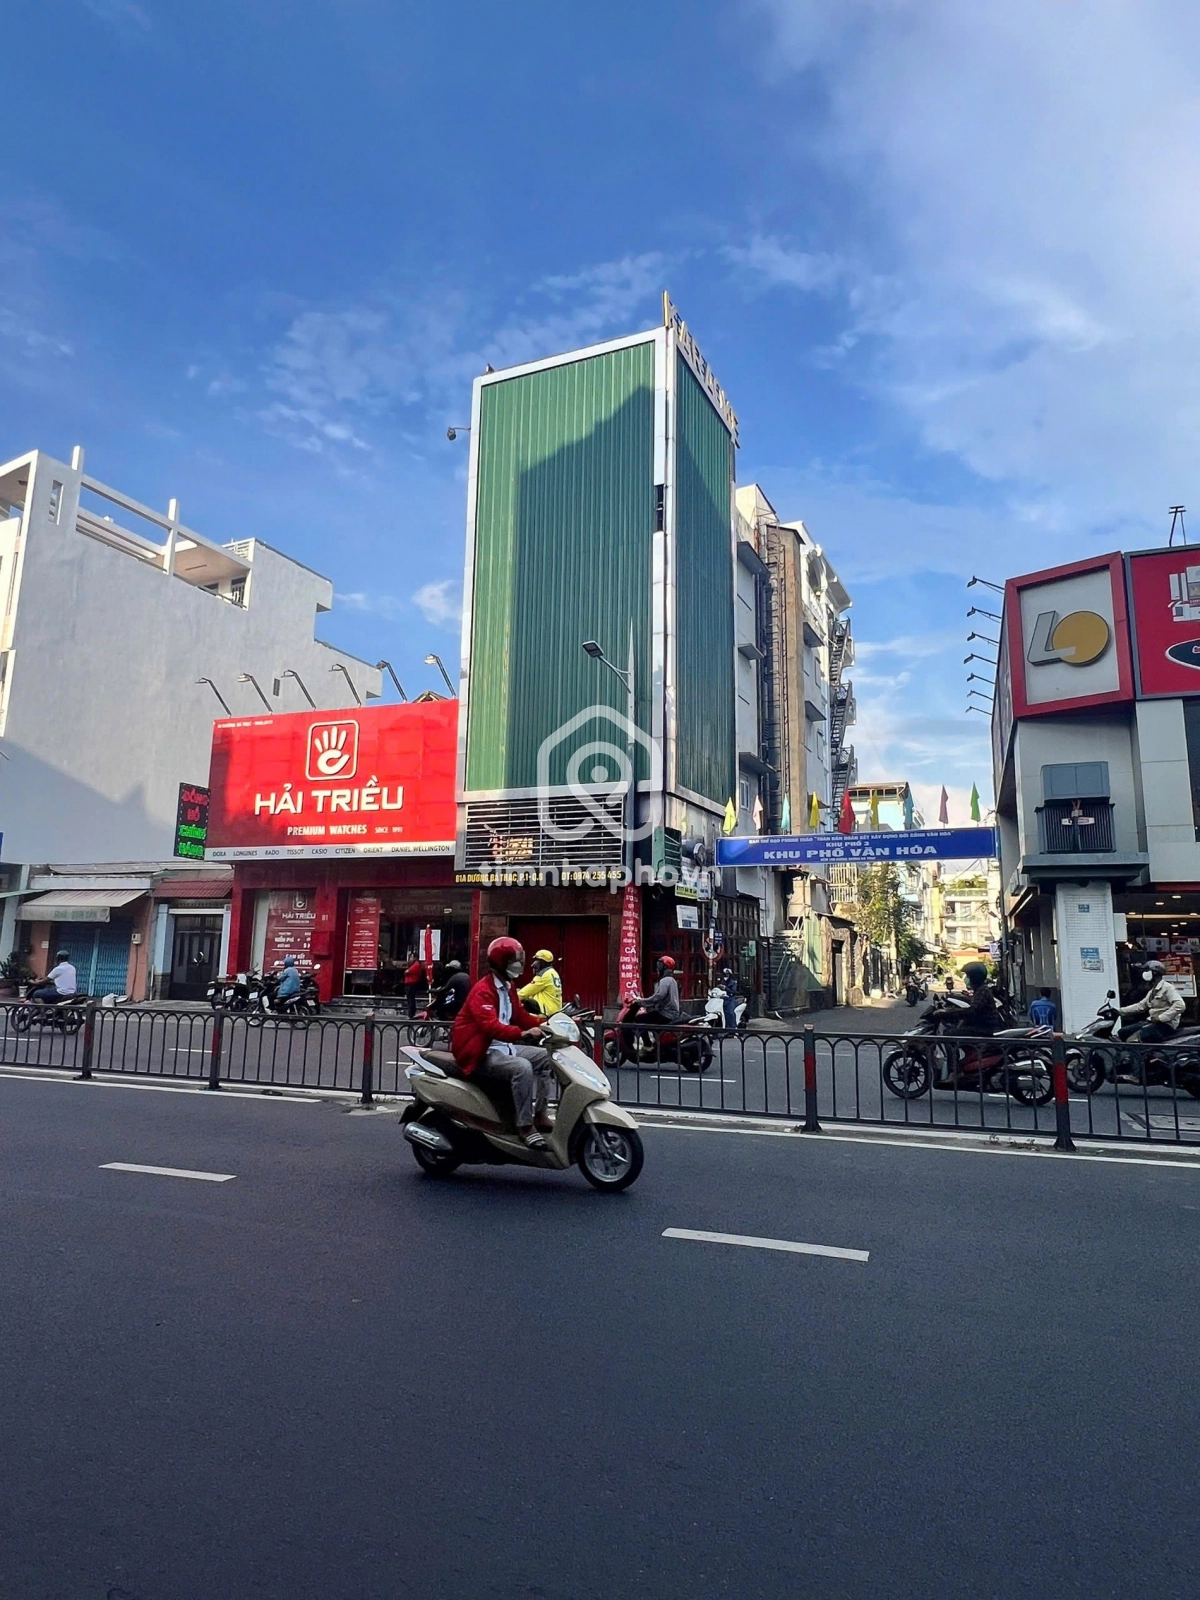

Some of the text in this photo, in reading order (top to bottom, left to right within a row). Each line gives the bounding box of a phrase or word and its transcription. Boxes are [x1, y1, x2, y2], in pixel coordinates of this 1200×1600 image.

[254, 775, 404, 815] HẢI TRIỀU
[287, 826, 326, 836] PREMIUM
[329, 824, 367, 835] WATCHES
[413, 844, 450, 852] WELLINGTON
[763, 850, 801, 860] KHU
[806, 847, 844, 859] PHỐ
[849, 846, 890, 857] VĂN
[896, 844, 937, 855] HÓA
